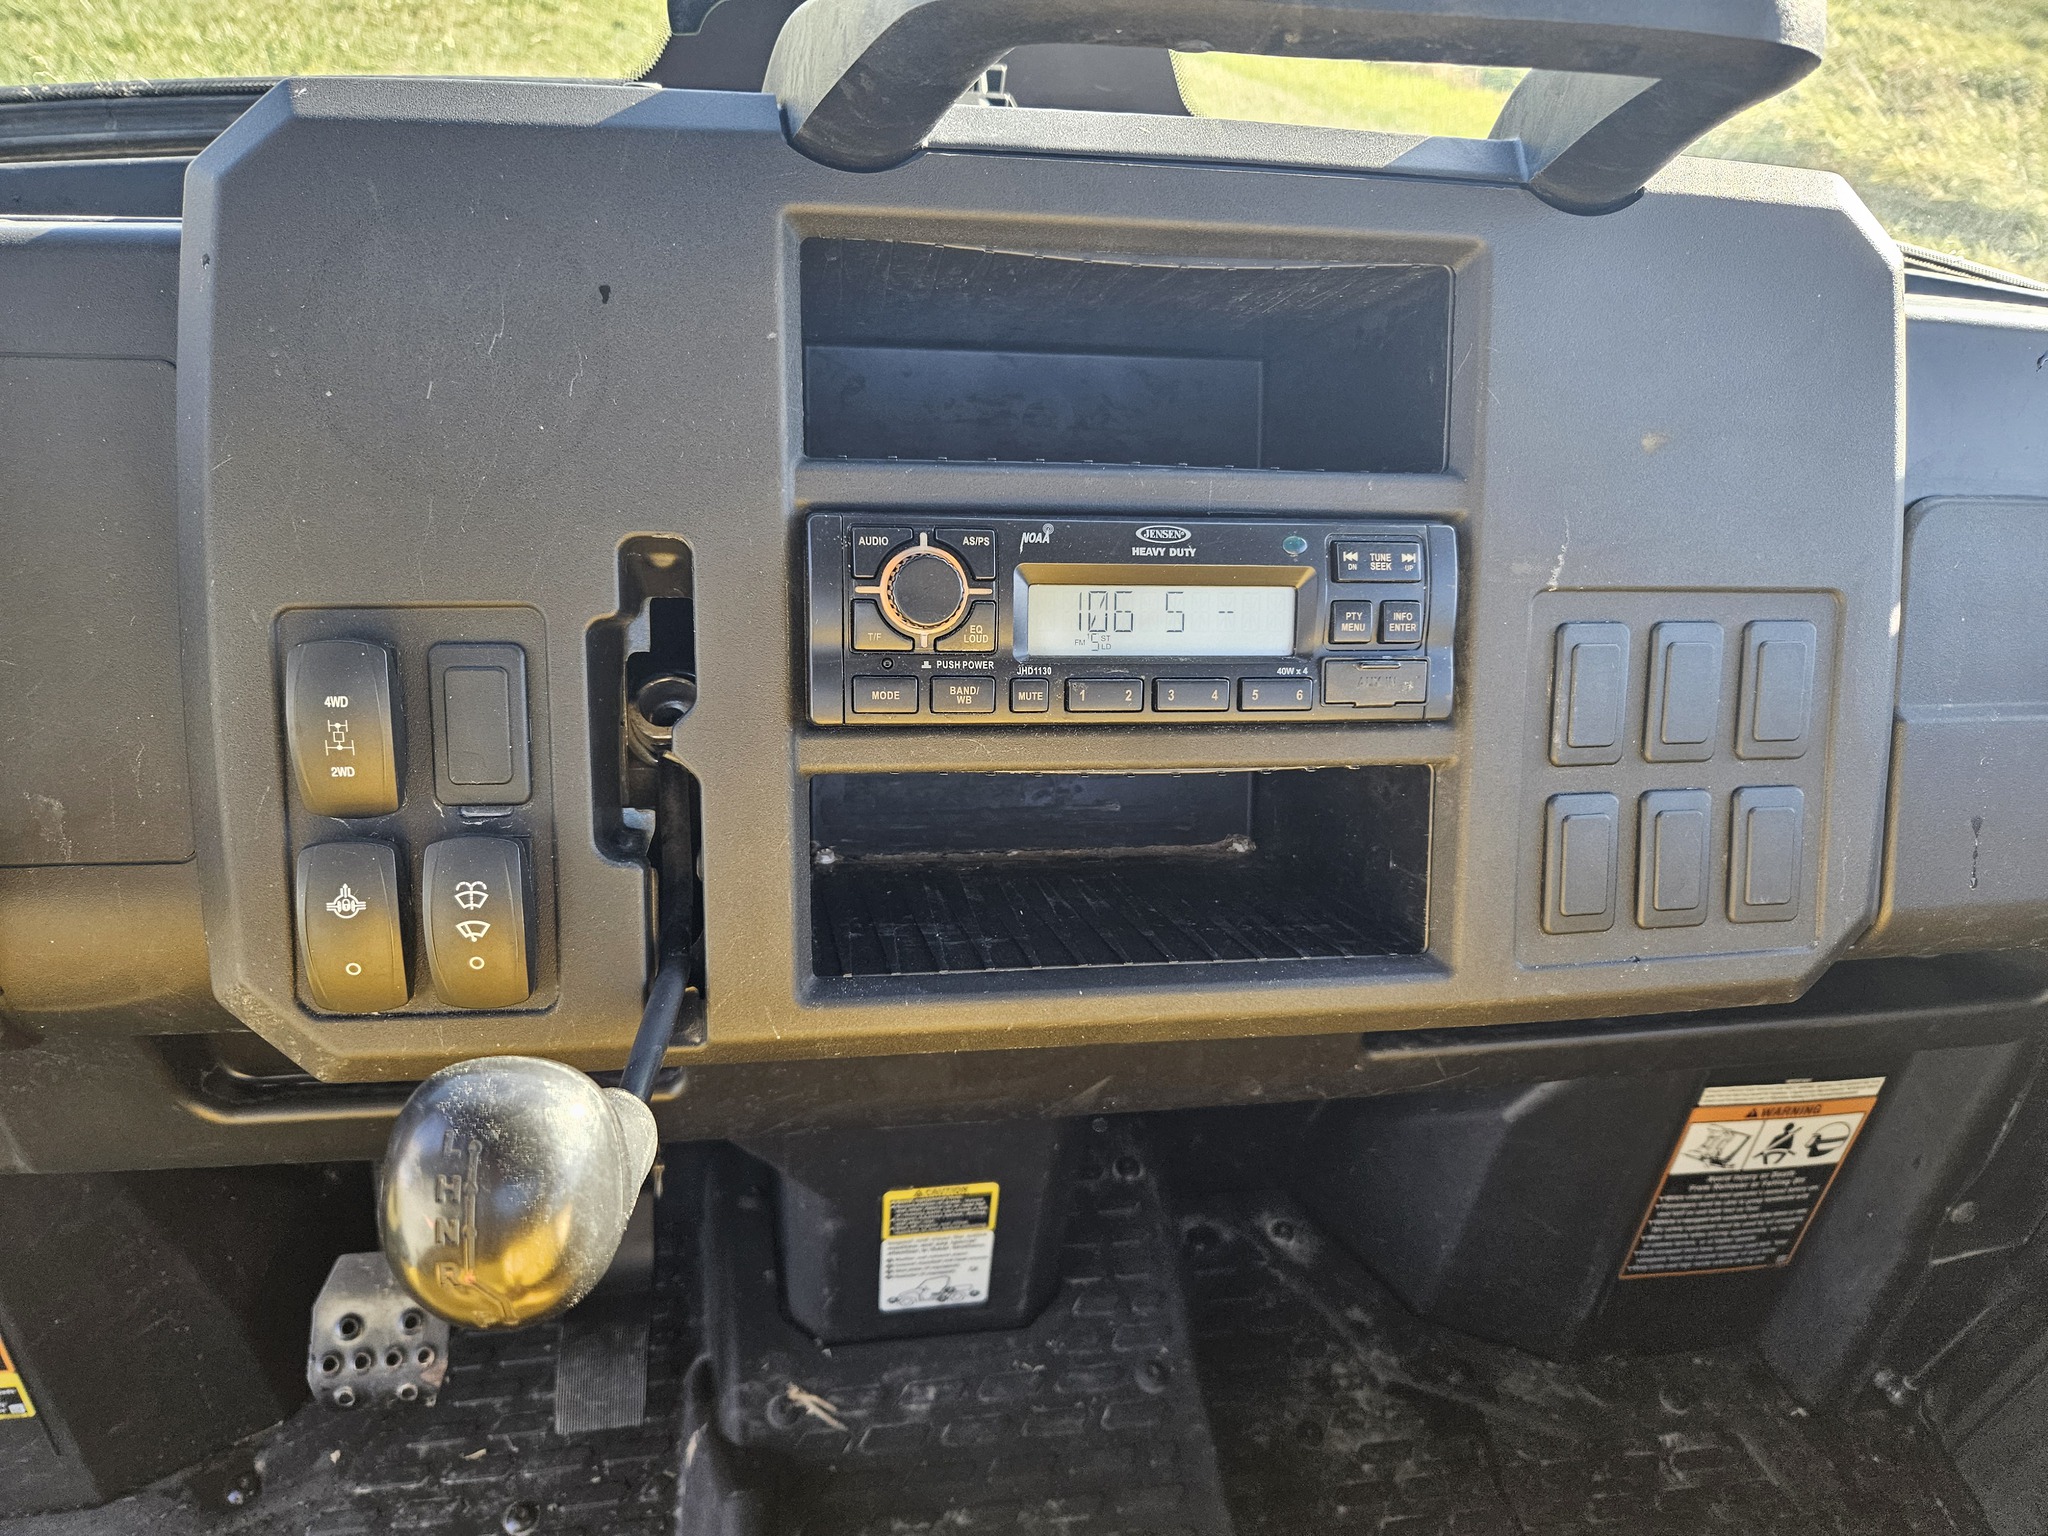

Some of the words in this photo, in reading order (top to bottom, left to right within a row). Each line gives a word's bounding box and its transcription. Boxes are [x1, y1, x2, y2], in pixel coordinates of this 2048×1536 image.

[1143, 529, 1182, 539] JENSEN
[858, 536, 889, 547] AUDIO
[962, 536, 990, 547] AS/PS
[1131, 547, 1166, 557] HEAVY
[1169, 547, 1197, 557] DUTY
[1369, 552, 1392, 562] TUNE
[1347, 563, 1358, 571] DN
[1370, 562, 1392, 571] SEEK
[1404, 564, 1414, 572] UP
[1078, 591, 1134, 632] 106
[1345, 612, 1362, 621] PTY
[1393, 612, 1413, 622] INFO
[970, 625, 983, 635] EQ
[1341, 622, 1366, 632] MENU
[1389, 623, 1417, 632] ENTER
[868, 632, 882, 642] T/F
[963, 634, 989, 644] LOUD
[936, 660, 961, 670] PUSH
[962, 660, 995, 670] POWER
[1016, 666, 1052, 675] JHD1130
[1276, 667, 1295, 675] 40W
[1302, 667, 1308, 675] 4
[871, 691, 900, 700] MODE
[950, 686, 980, 696] BAND/
[1018, 691, 1043, 701] MUTE
[1079, 690, 1086, 701] 1
[1125, 690, 1132, 701] 2
[1168, 690, 1175, 701] 3
[1211, 690, 1218, 701] 4
[1252, 690, 1259, 701] 5
[1296, 690, 1303, 700] 6
[324, 696, 349, 708] 4WD
[956, 696, 972, 704] WB
[331, 766, 355, 778] 2WD
[1761, 1104, 1822, 1117] WARNING
[435, 1174, 462, 1204] H
[434, 1217, 461, 1245] N
[436, 1261, 462, 1287] R
